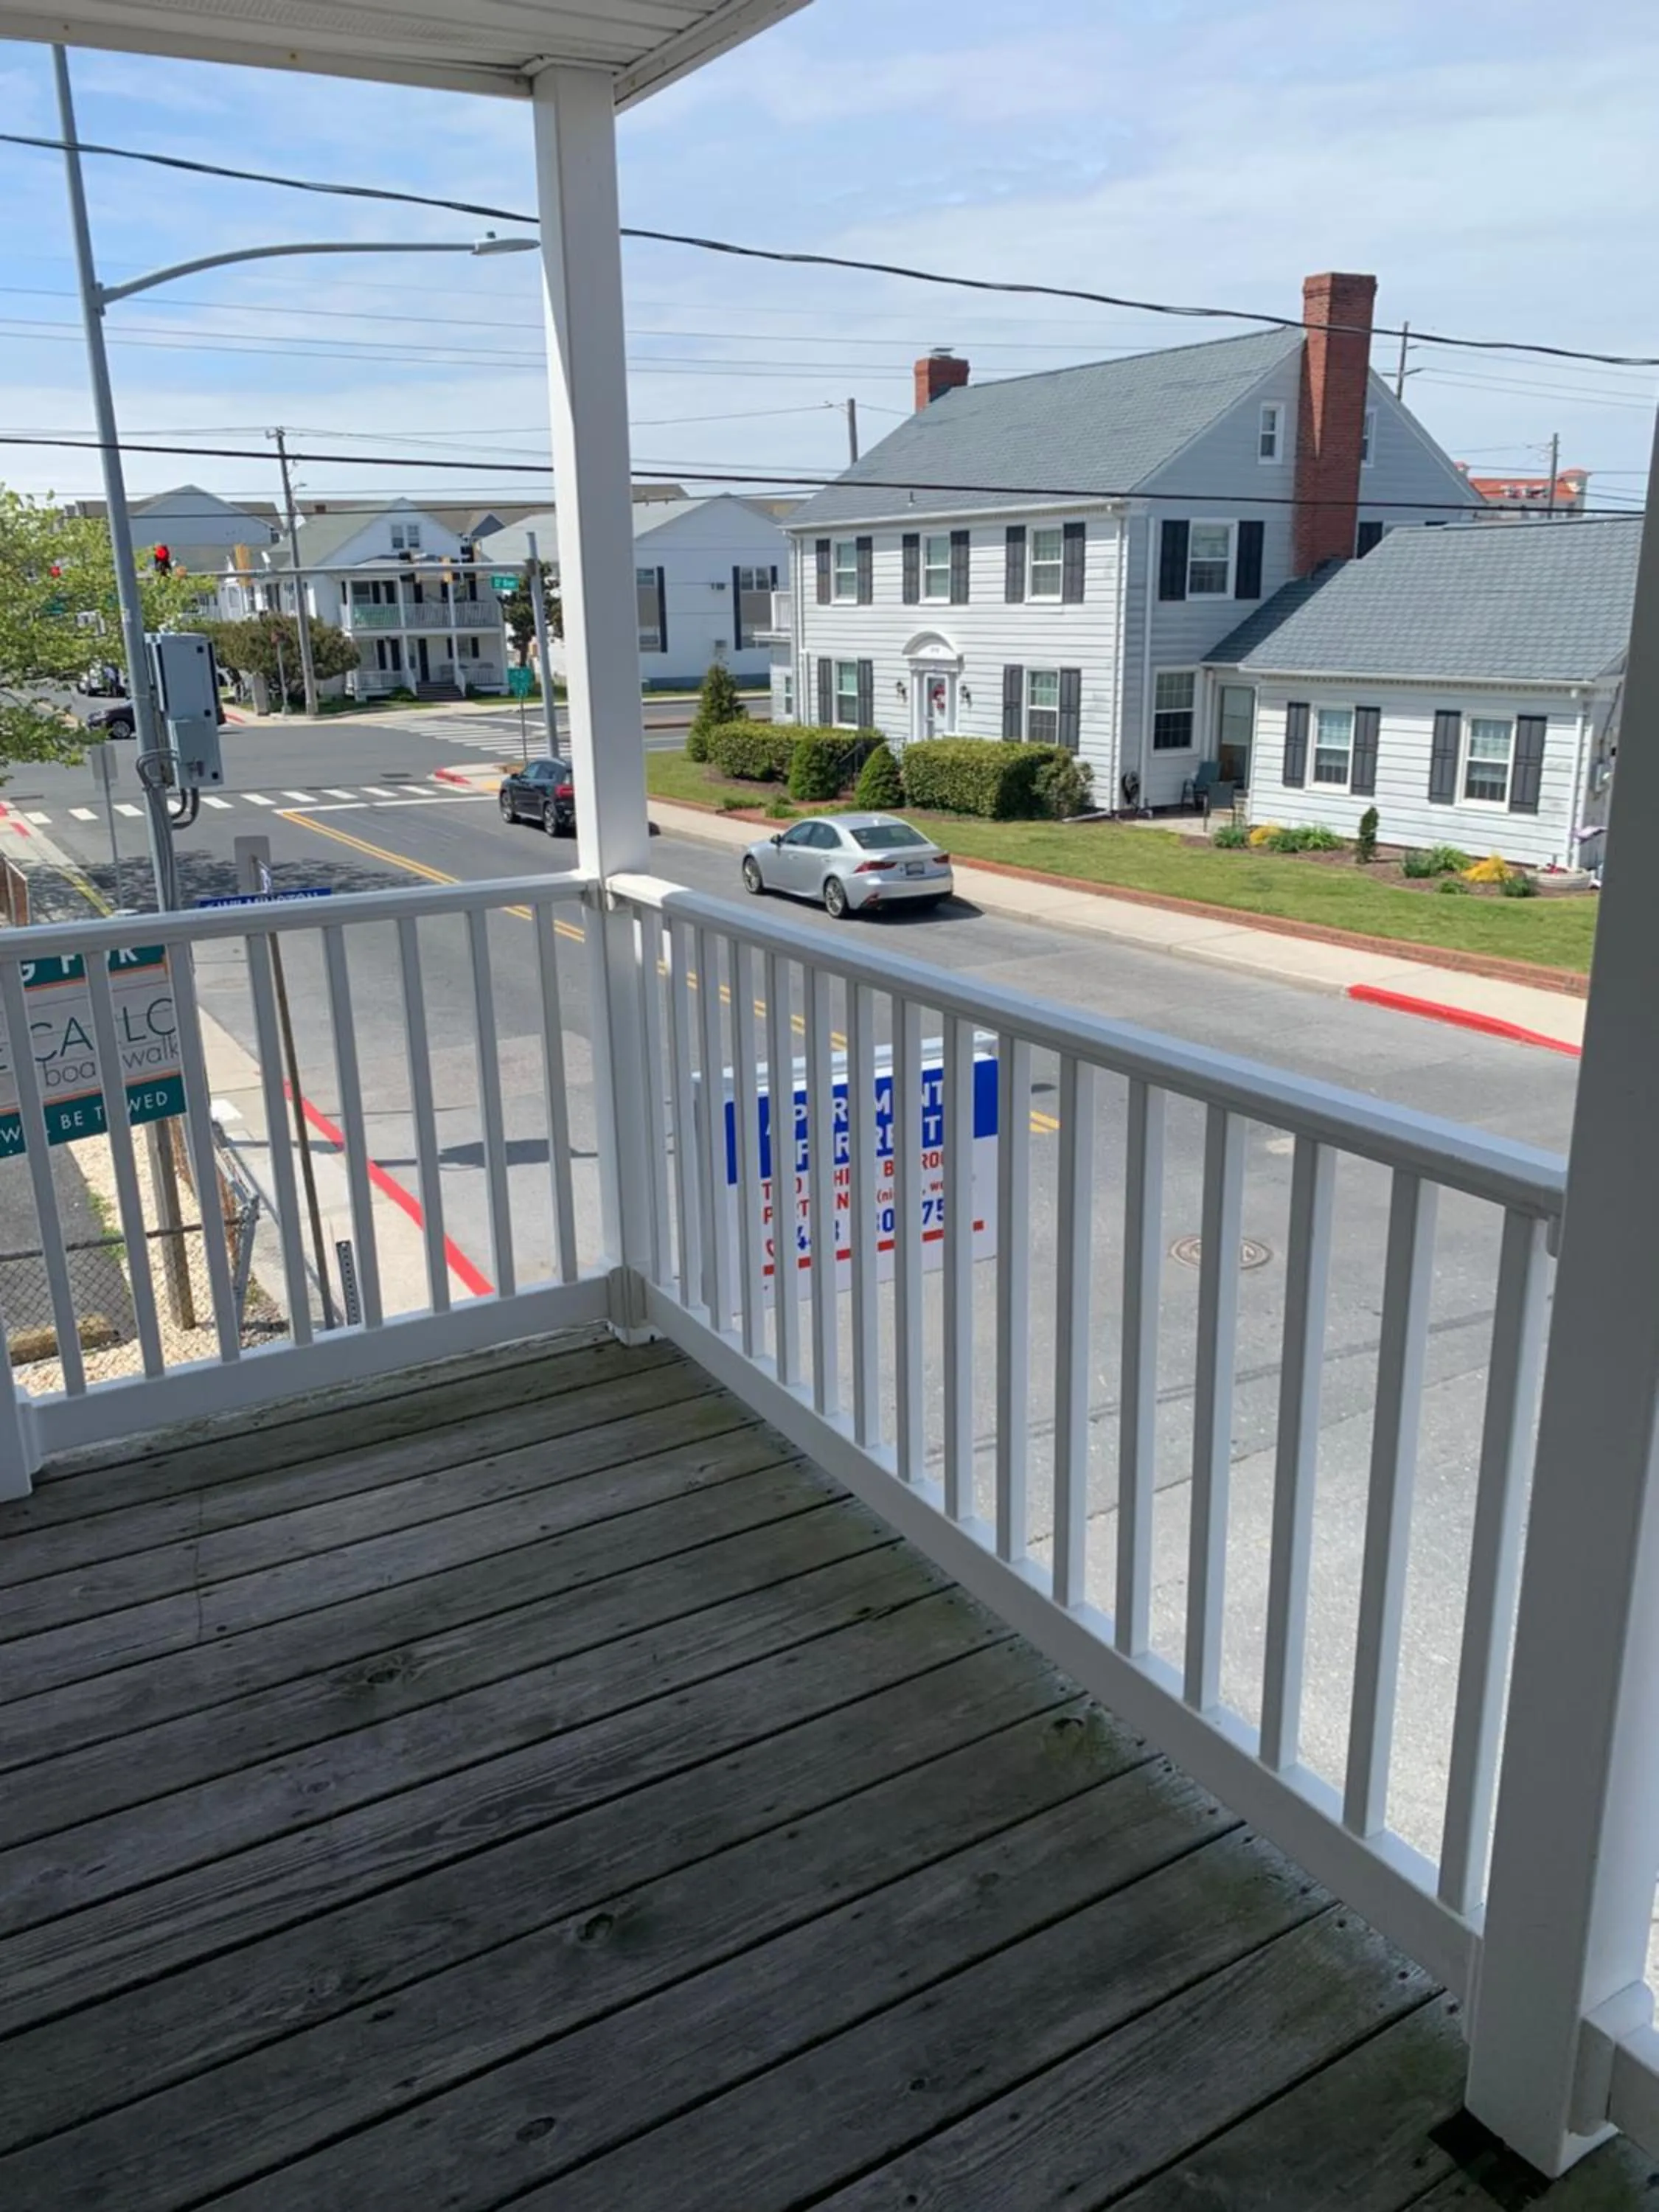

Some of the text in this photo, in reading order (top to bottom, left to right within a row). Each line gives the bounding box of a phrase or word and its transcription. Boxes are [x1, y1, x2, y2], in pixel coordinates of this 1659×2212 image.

[42, 1034, 179, 1087] boawalk
[60, 1091, 168, 1130] BE TWED
